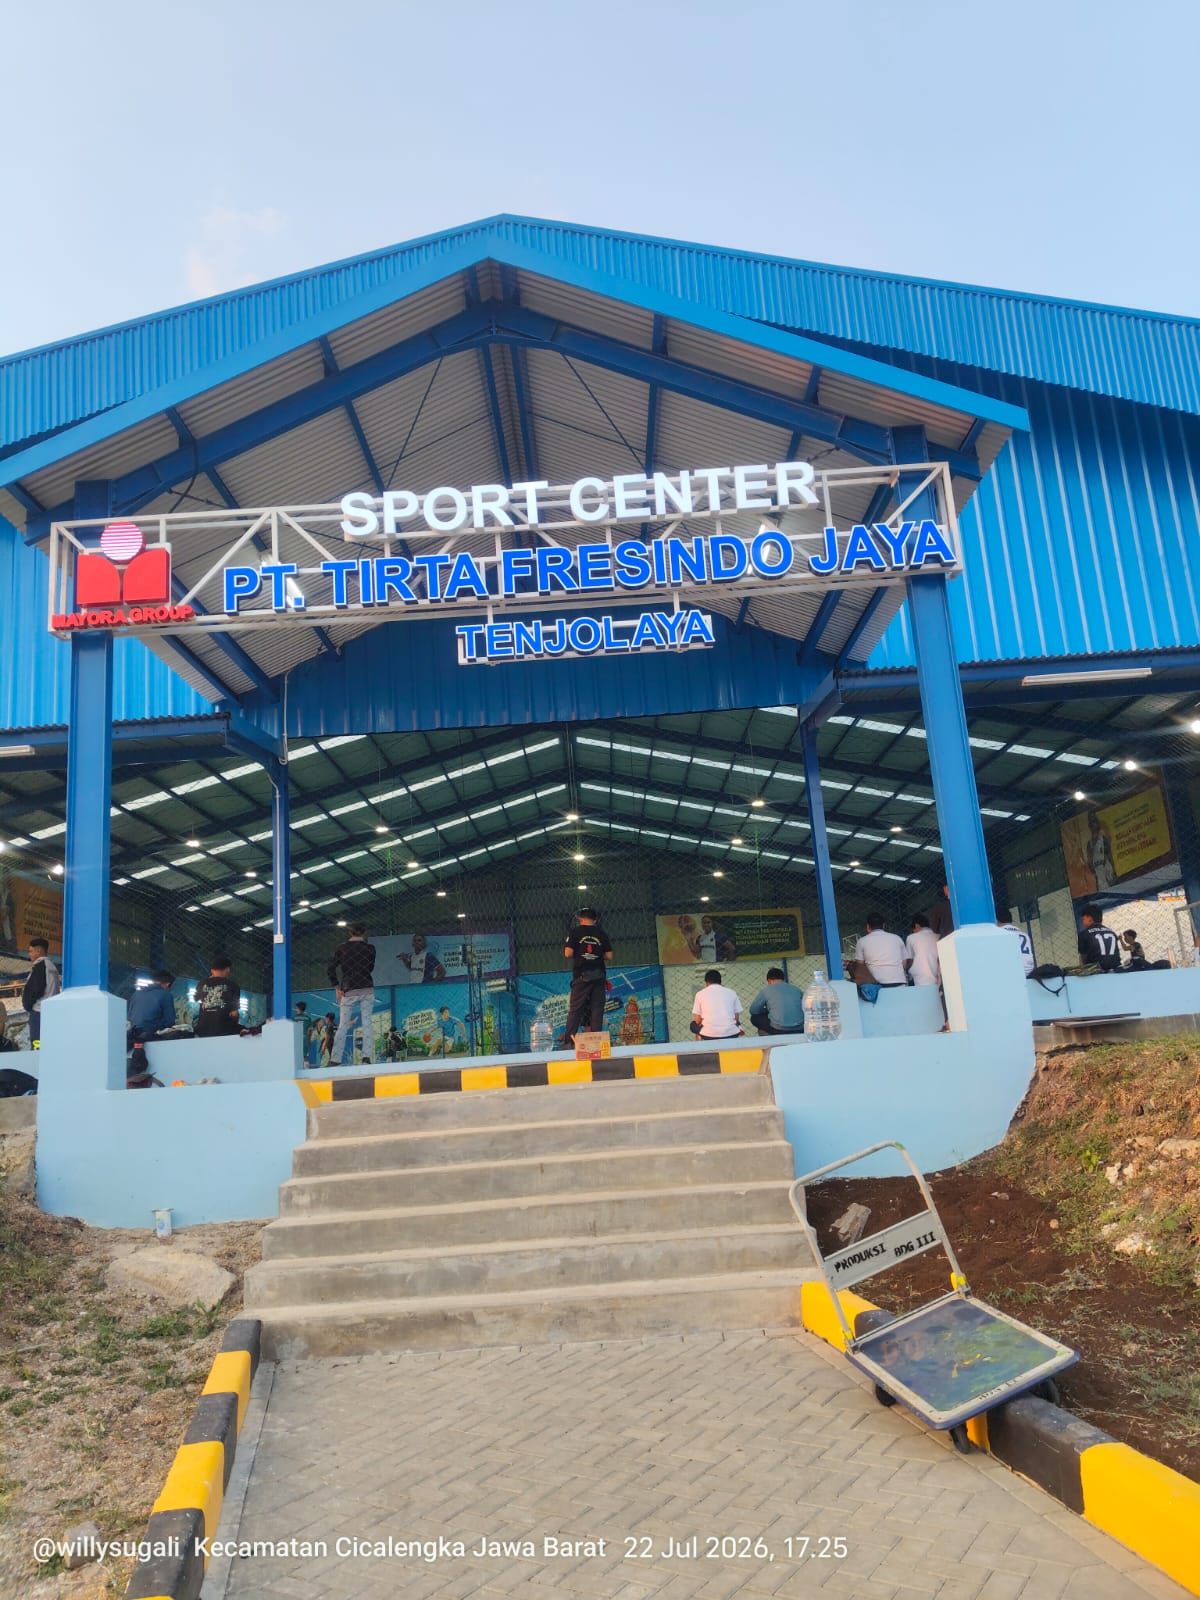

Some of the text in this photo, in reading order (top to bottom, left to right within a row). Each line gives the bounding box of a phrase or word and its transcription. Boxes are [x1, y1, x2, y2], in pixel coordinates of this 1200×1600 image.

[341, 461, 819, 539] SPORT CENTER
[223, 519, 957, 615] PT. TIRTA FRESINDO JAYA
[51, 604, 196, 630] MAYORA GROUP
[455, 609, 715, 662] TENJOLAYA
[1094, 933, 1116, 956] 17
[834, 1242, 887, 1273] PRODUKSI
[915, 1231, 937, 1249] III
